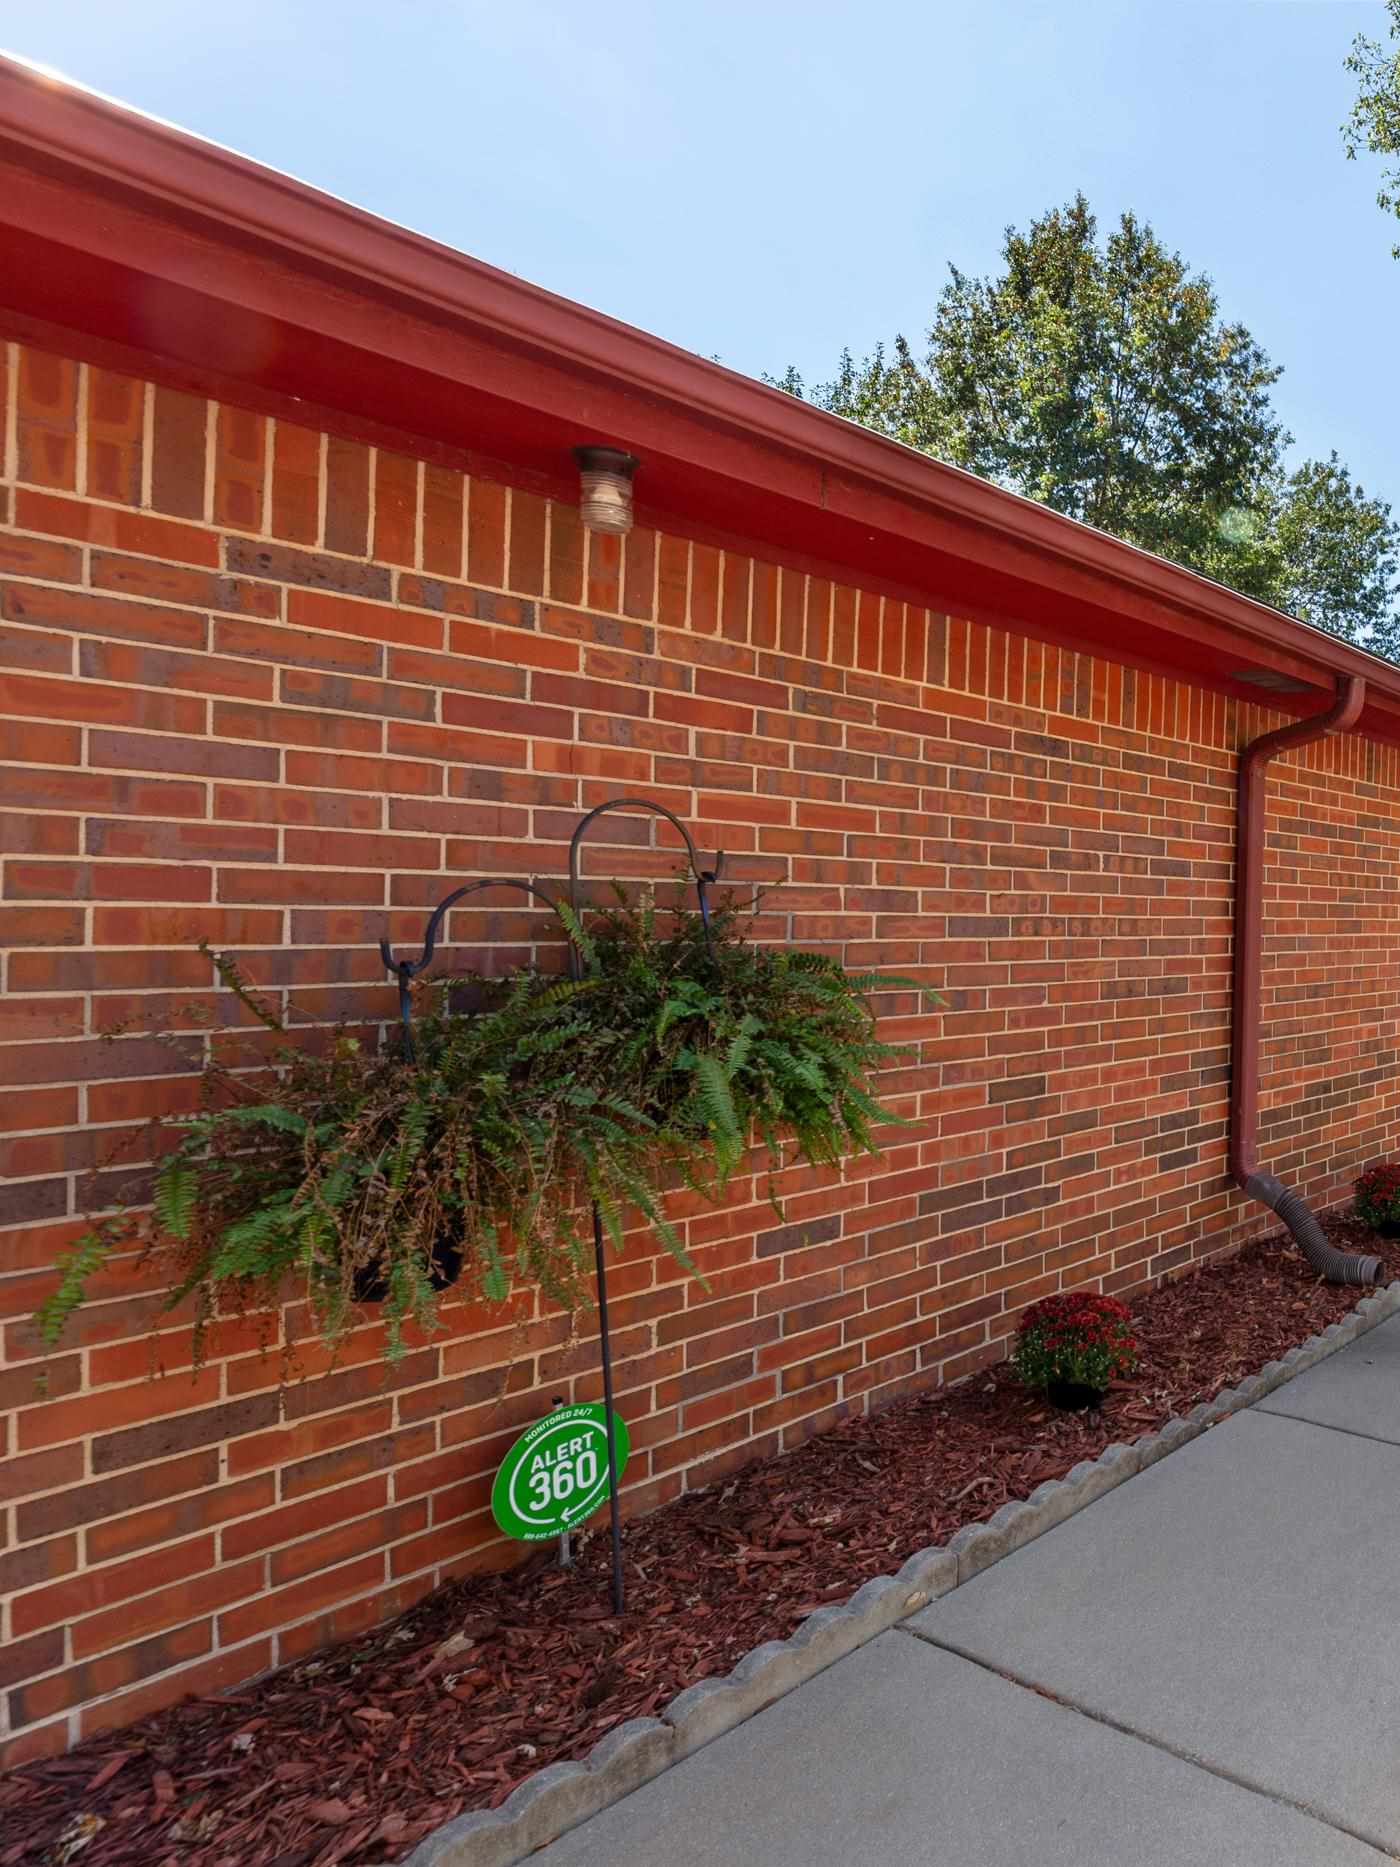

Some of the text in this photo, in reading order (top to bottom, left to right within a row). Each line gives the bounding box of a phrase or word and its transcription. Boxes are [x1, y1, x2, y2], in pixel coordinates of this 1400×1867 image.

[524, 1408, 593, 1443] MONITORED 24/7
[531, 1431, 594, 1474] ALERT
[529, 1450, 597, 1511] 360
